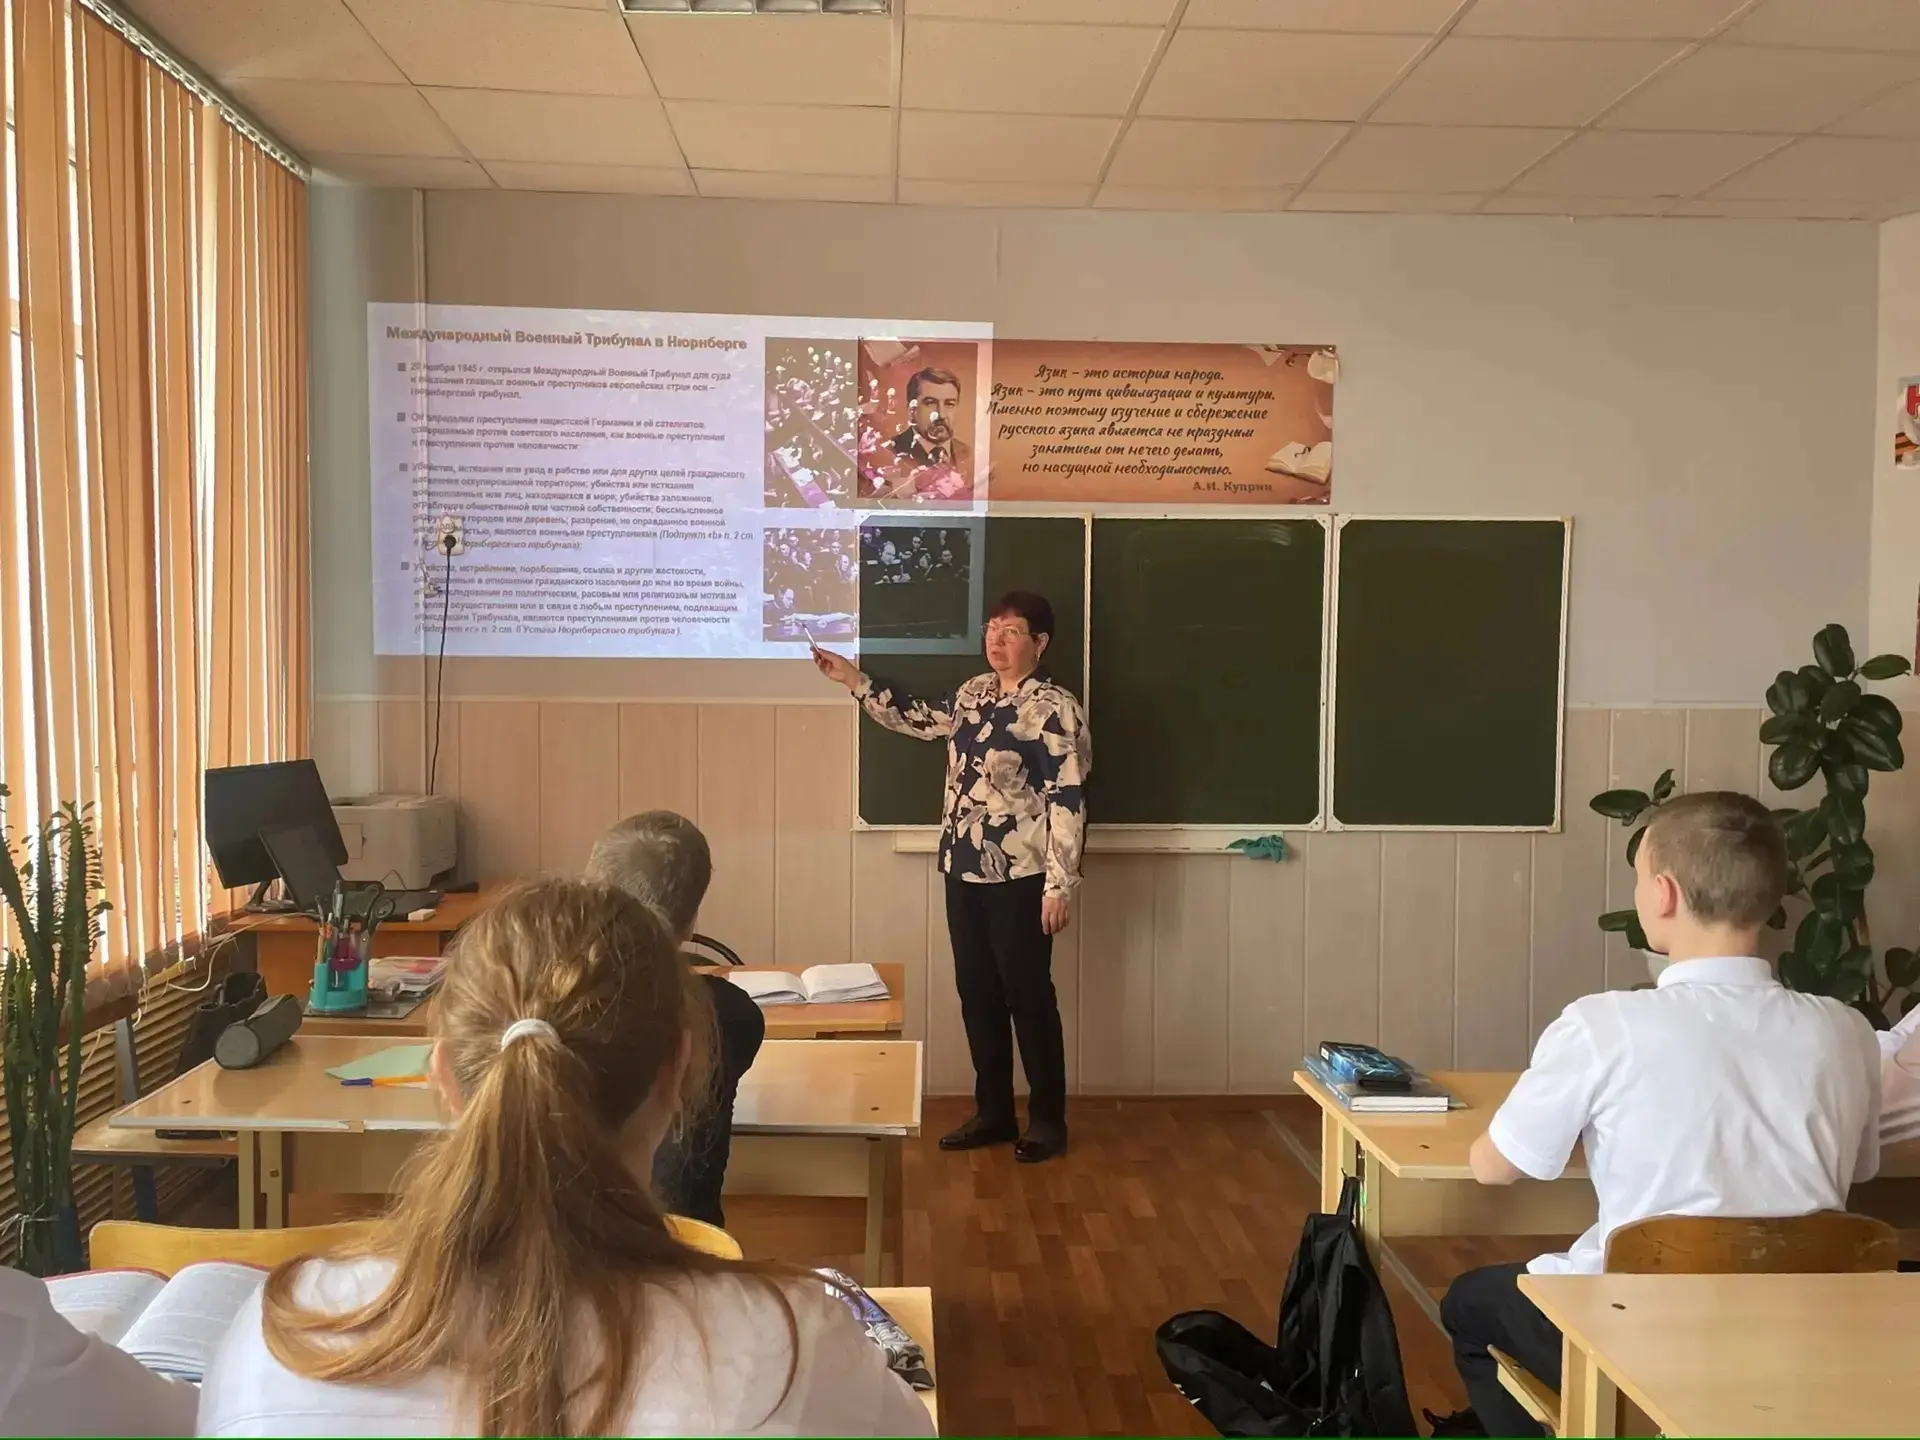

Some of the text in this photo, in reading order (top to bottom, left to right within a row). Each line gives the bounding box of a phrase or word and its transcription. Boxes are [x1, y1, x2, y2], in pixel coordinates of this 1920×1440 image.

[386, 326, 512, 343] Международный
[515, 331, 582, 344] Военный
[585, 333, 651, 348] Трибунал
[668, 335, 747, 351] Нюрнберге
[1034, 364, 1068, 382] Язык
[1083, 368, 1109, 379] это
[1113, 369, 1170, 384] история
[1174, 371, 1225, 386] народа.
[991, 382, 1024, 401] Язык
[1038, 386, 1064, 397] это
[1068, 387, 1102, 402] путь
[1106, 383, 1192, 404] цивилизации
[1195, 390, 1204, 398] и
[1207, 389, 1275, 405] культуры.
[987, 401, 1268, 423] Именно поэтому изучение и сбережение
[998, 421, 1254, 443] русского языка является не праздным
[1028, 443, 1224, 461] занятием от нечего делать,
[1022, 459, 1232, 480] но насущной необходимостью.
[1224, 482, 1273, 494] Куприн
